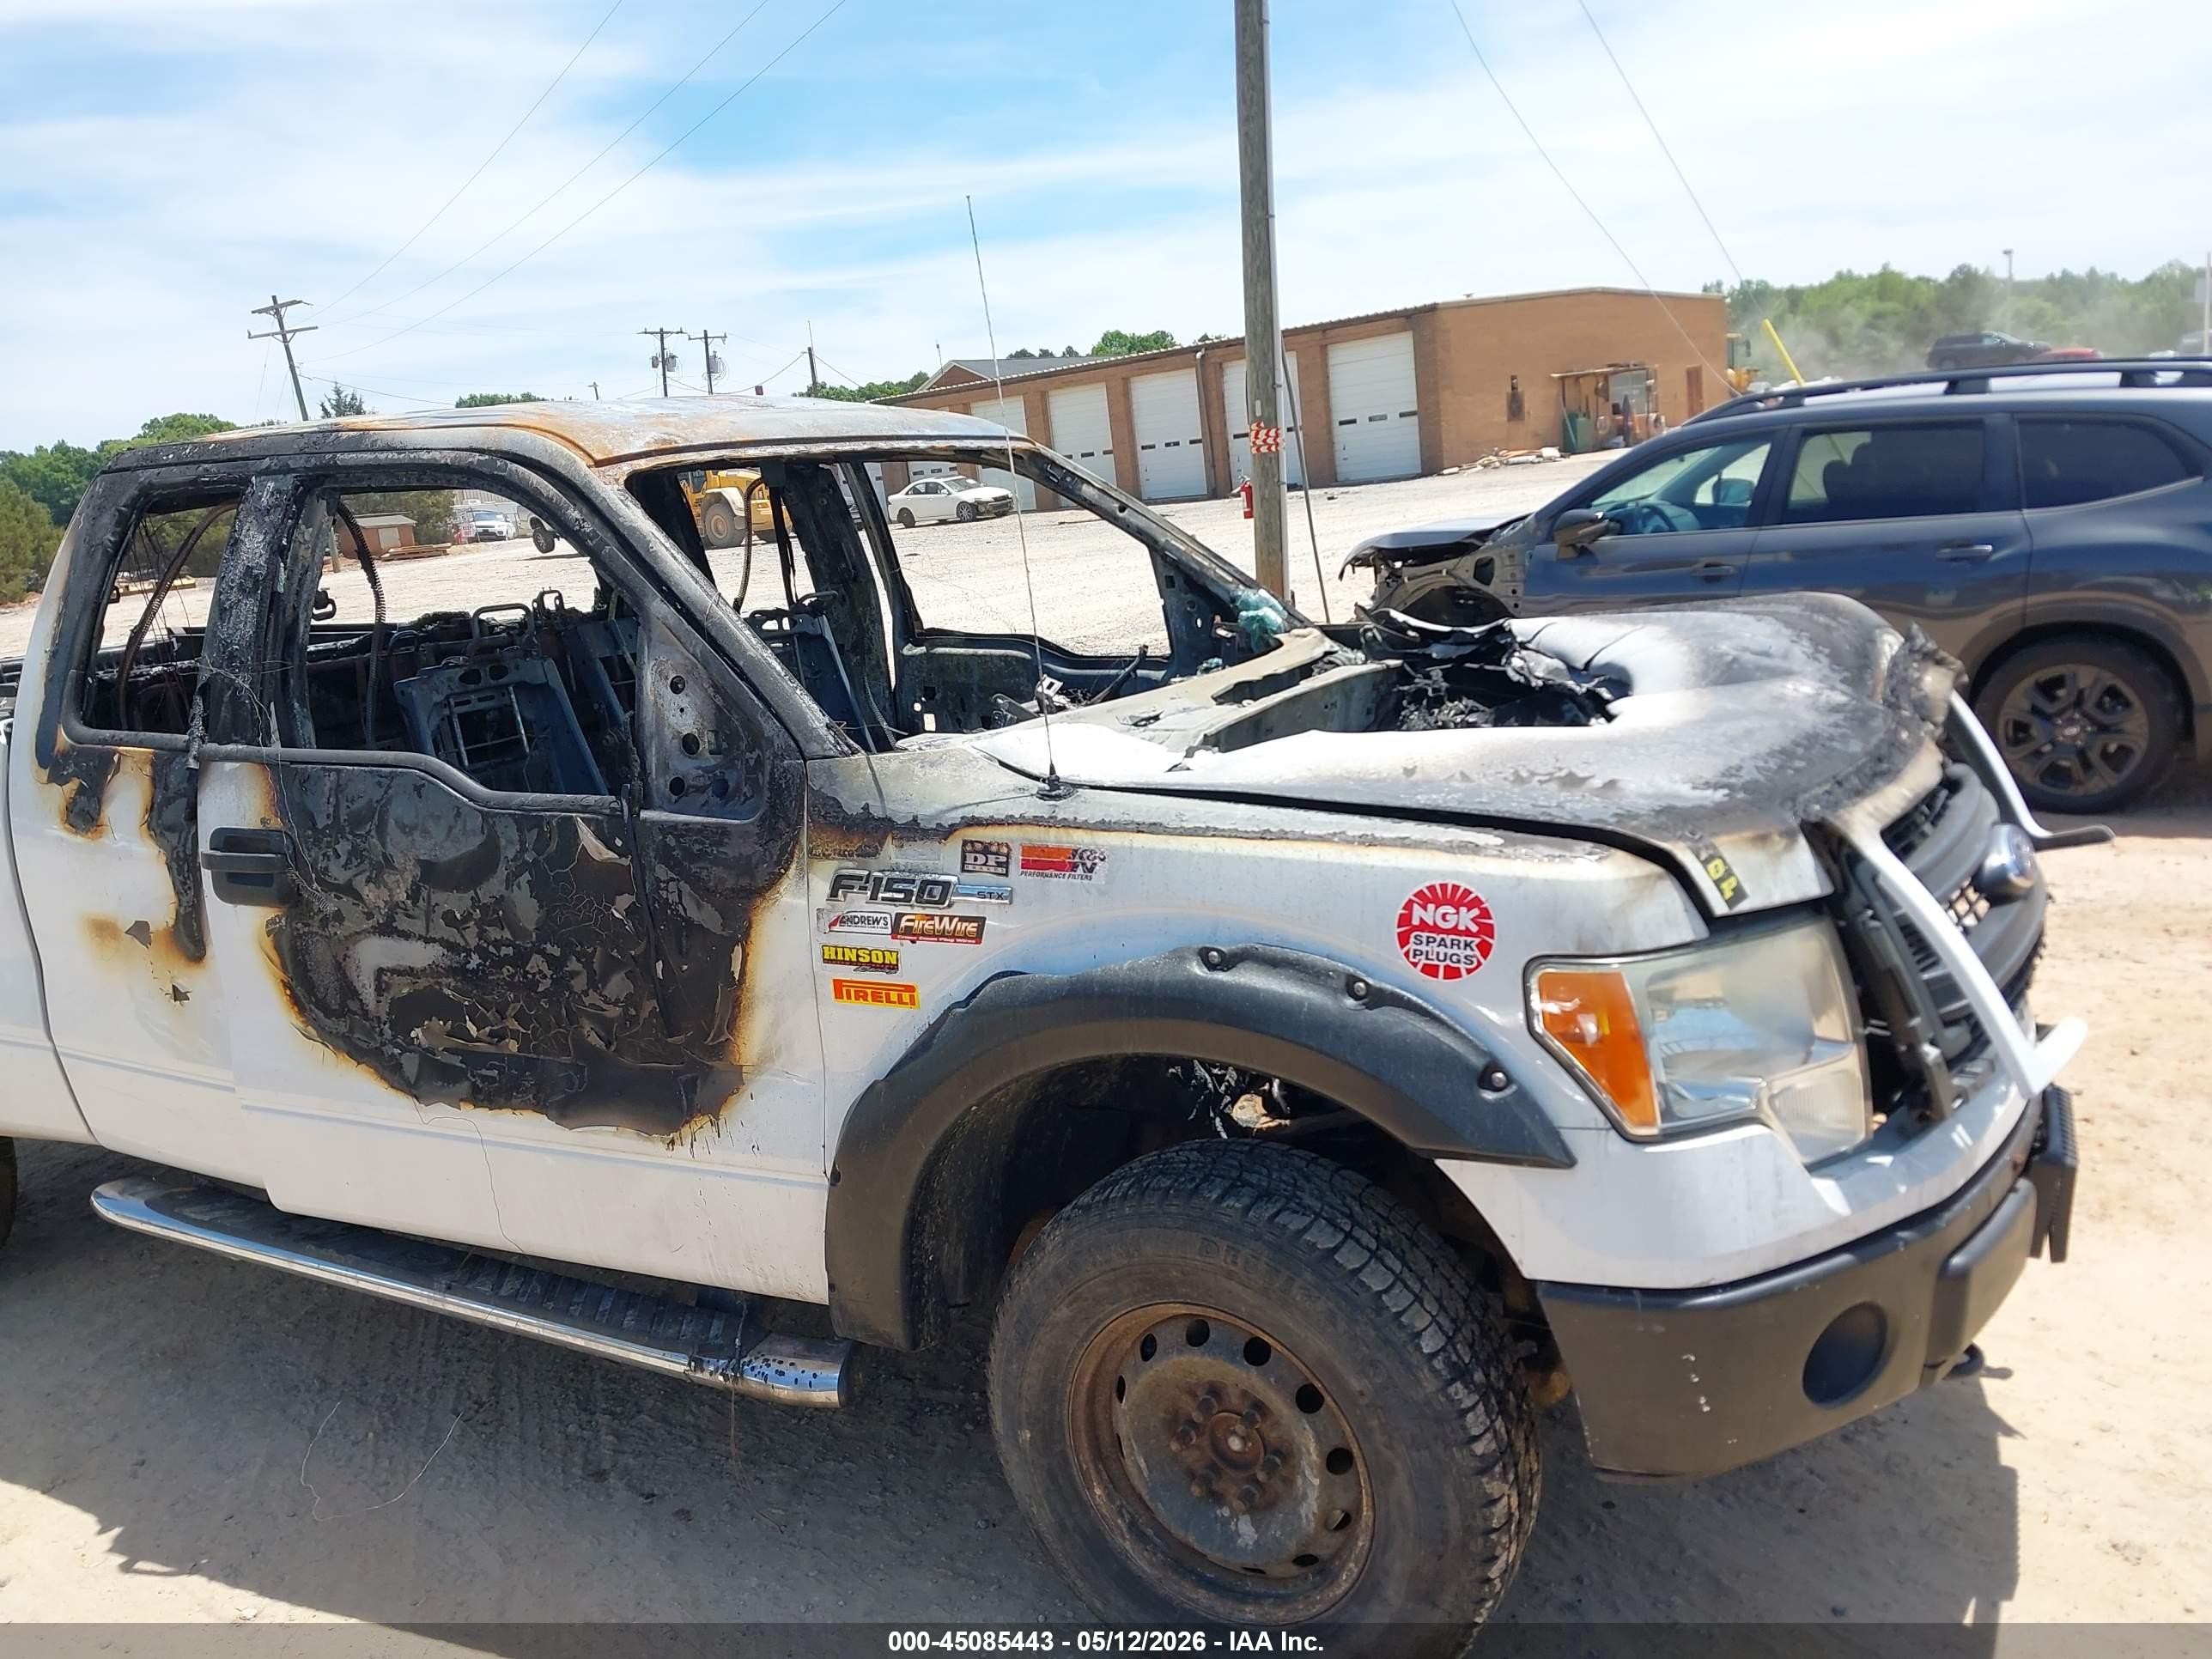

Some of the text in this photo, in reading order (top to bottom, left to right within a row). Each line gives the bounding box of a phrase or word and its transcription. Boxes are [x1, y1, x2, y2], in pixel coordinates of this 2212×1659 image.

[965, 853, 1006, 866] DP
[1019, 870, 1093, 881] PERFORMANCE FILTERS
[827, 870, 957, 908] F-150
[976, 890, 1005, 900] STX
[1412, 904, 1480, 933] NGK
[1413, 933, 1474, 951] SPARK
[823, 946, 897, 964] HINSON
[1413, 949, 1474, 966] PLUGS
[833, 979, 916, 1006] PIRELLI
